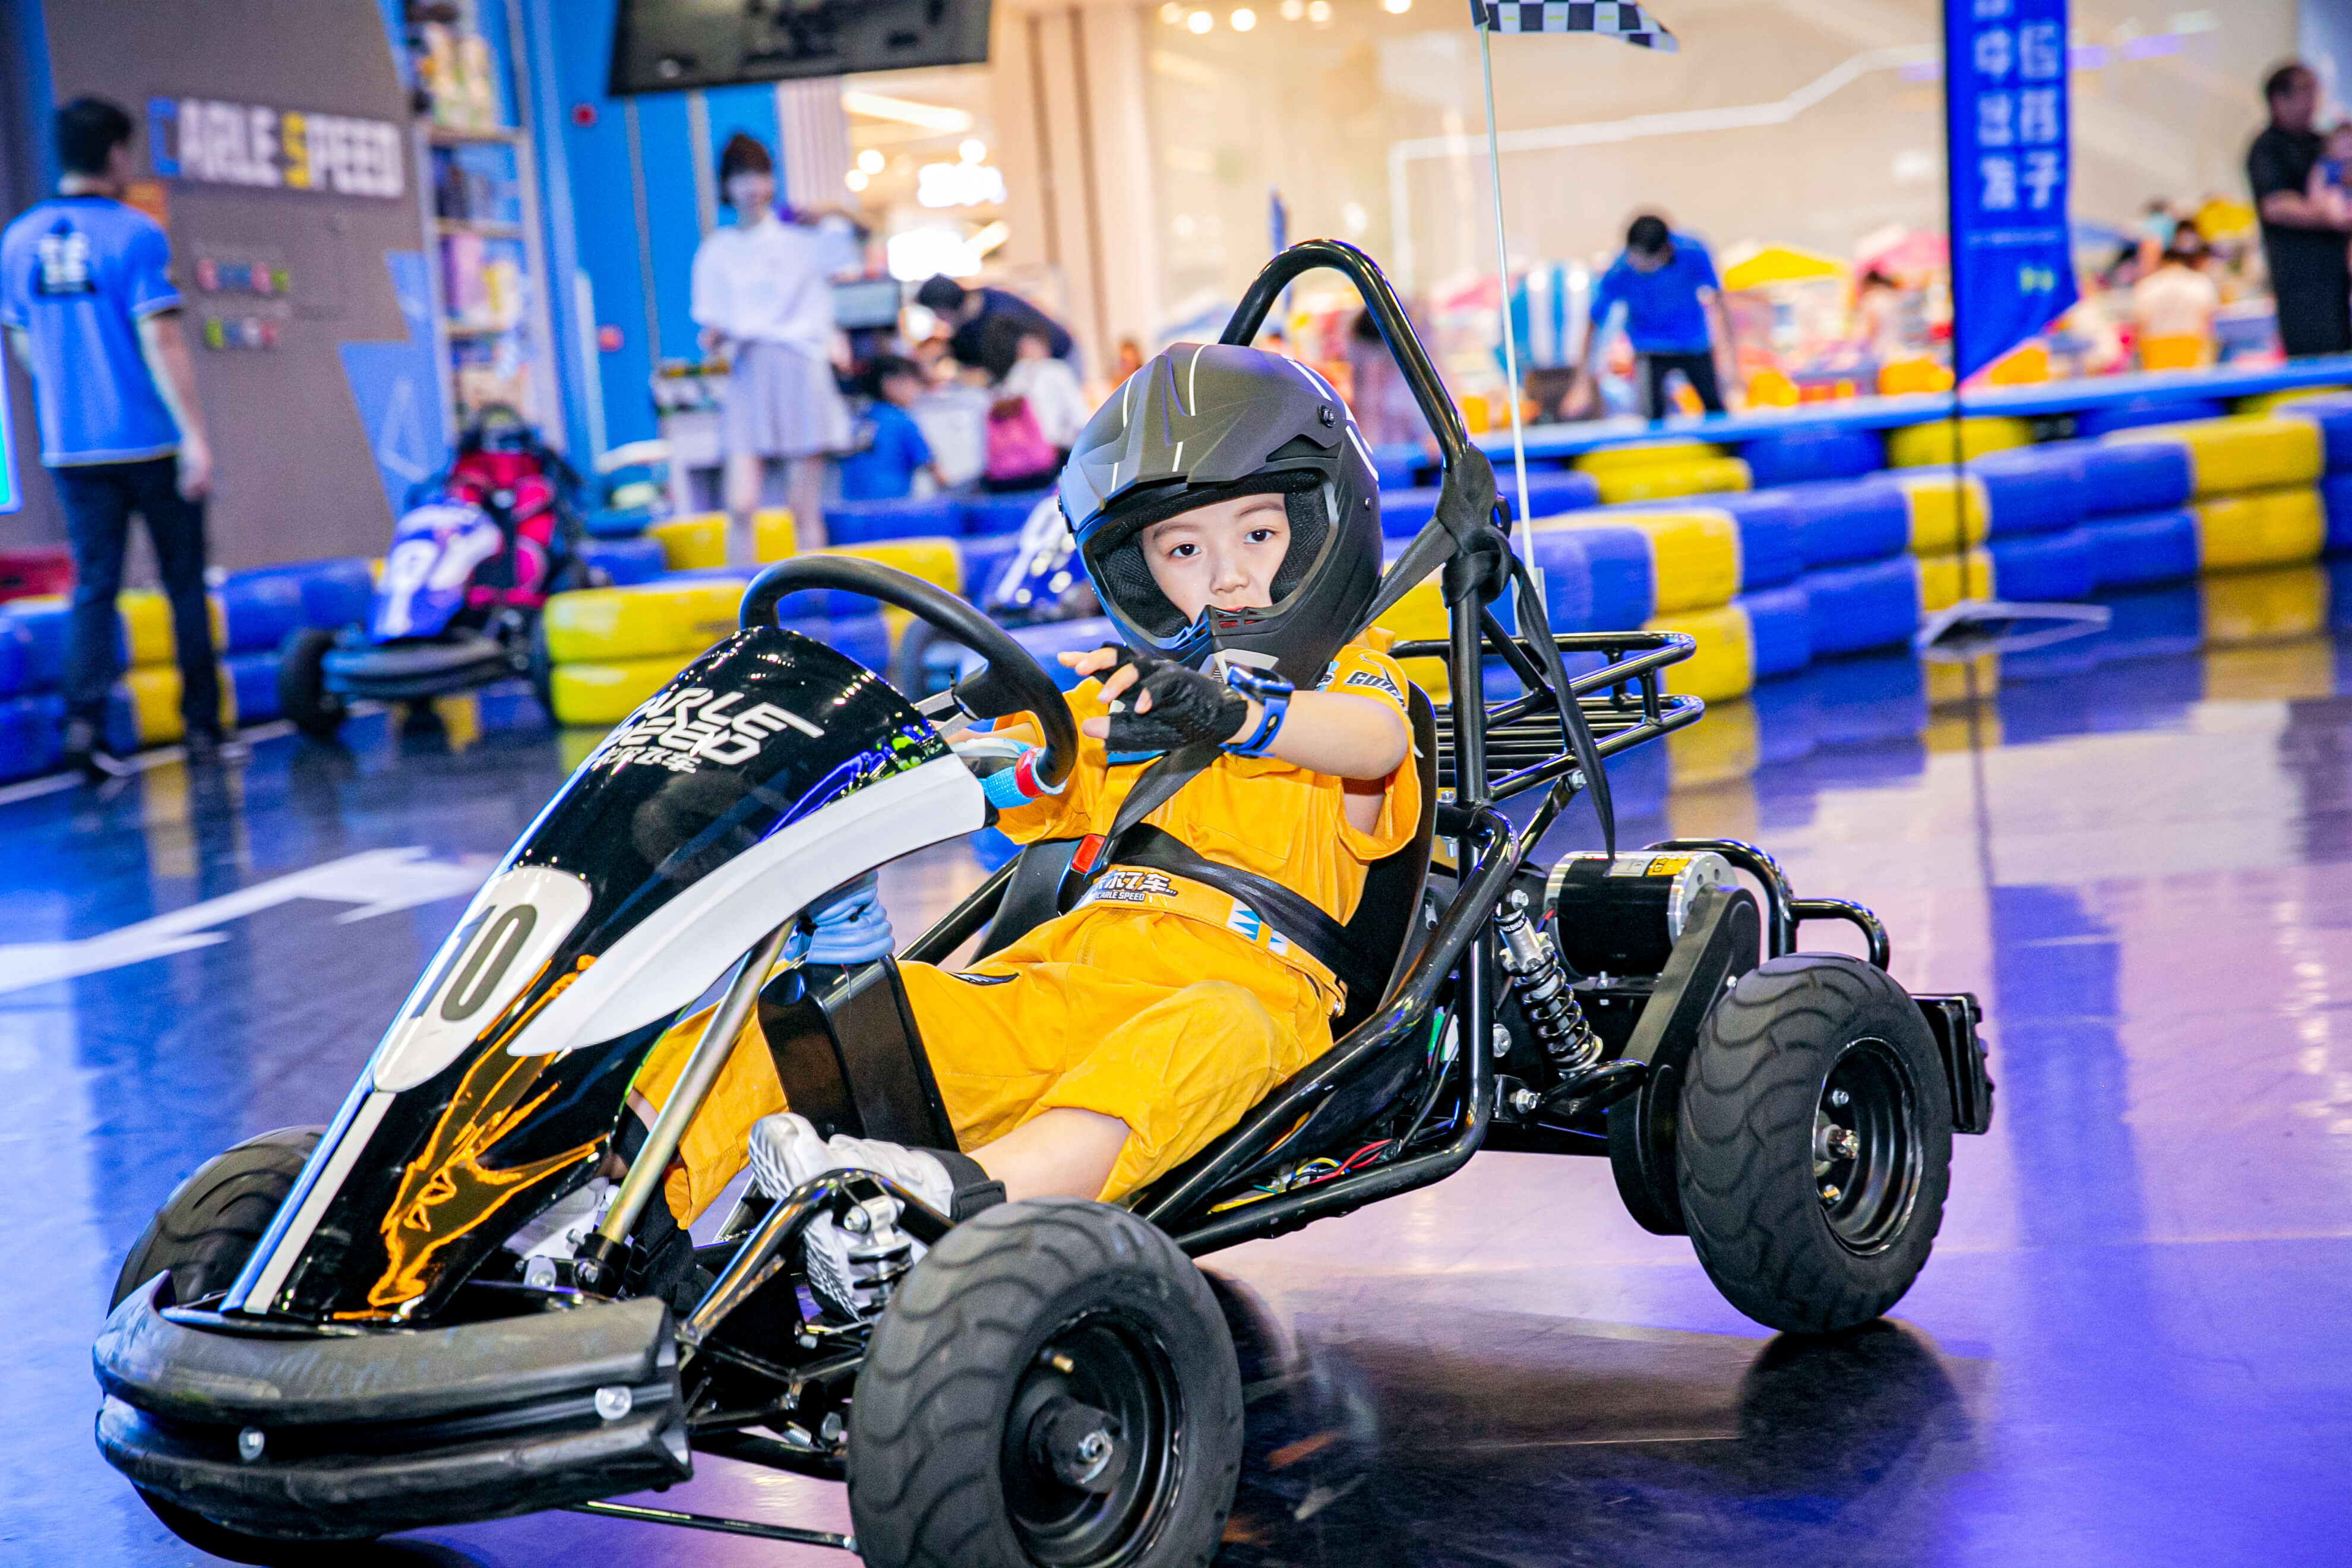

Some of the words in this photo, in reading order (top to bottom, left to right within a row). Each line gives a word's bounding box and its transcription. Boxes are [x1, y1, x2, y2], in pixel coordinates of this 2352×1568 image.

[283, 112, 404, 197] SPEED
[1118, 892, 1145, 901] SPEED
[409, 904, 538, 1022] 10
